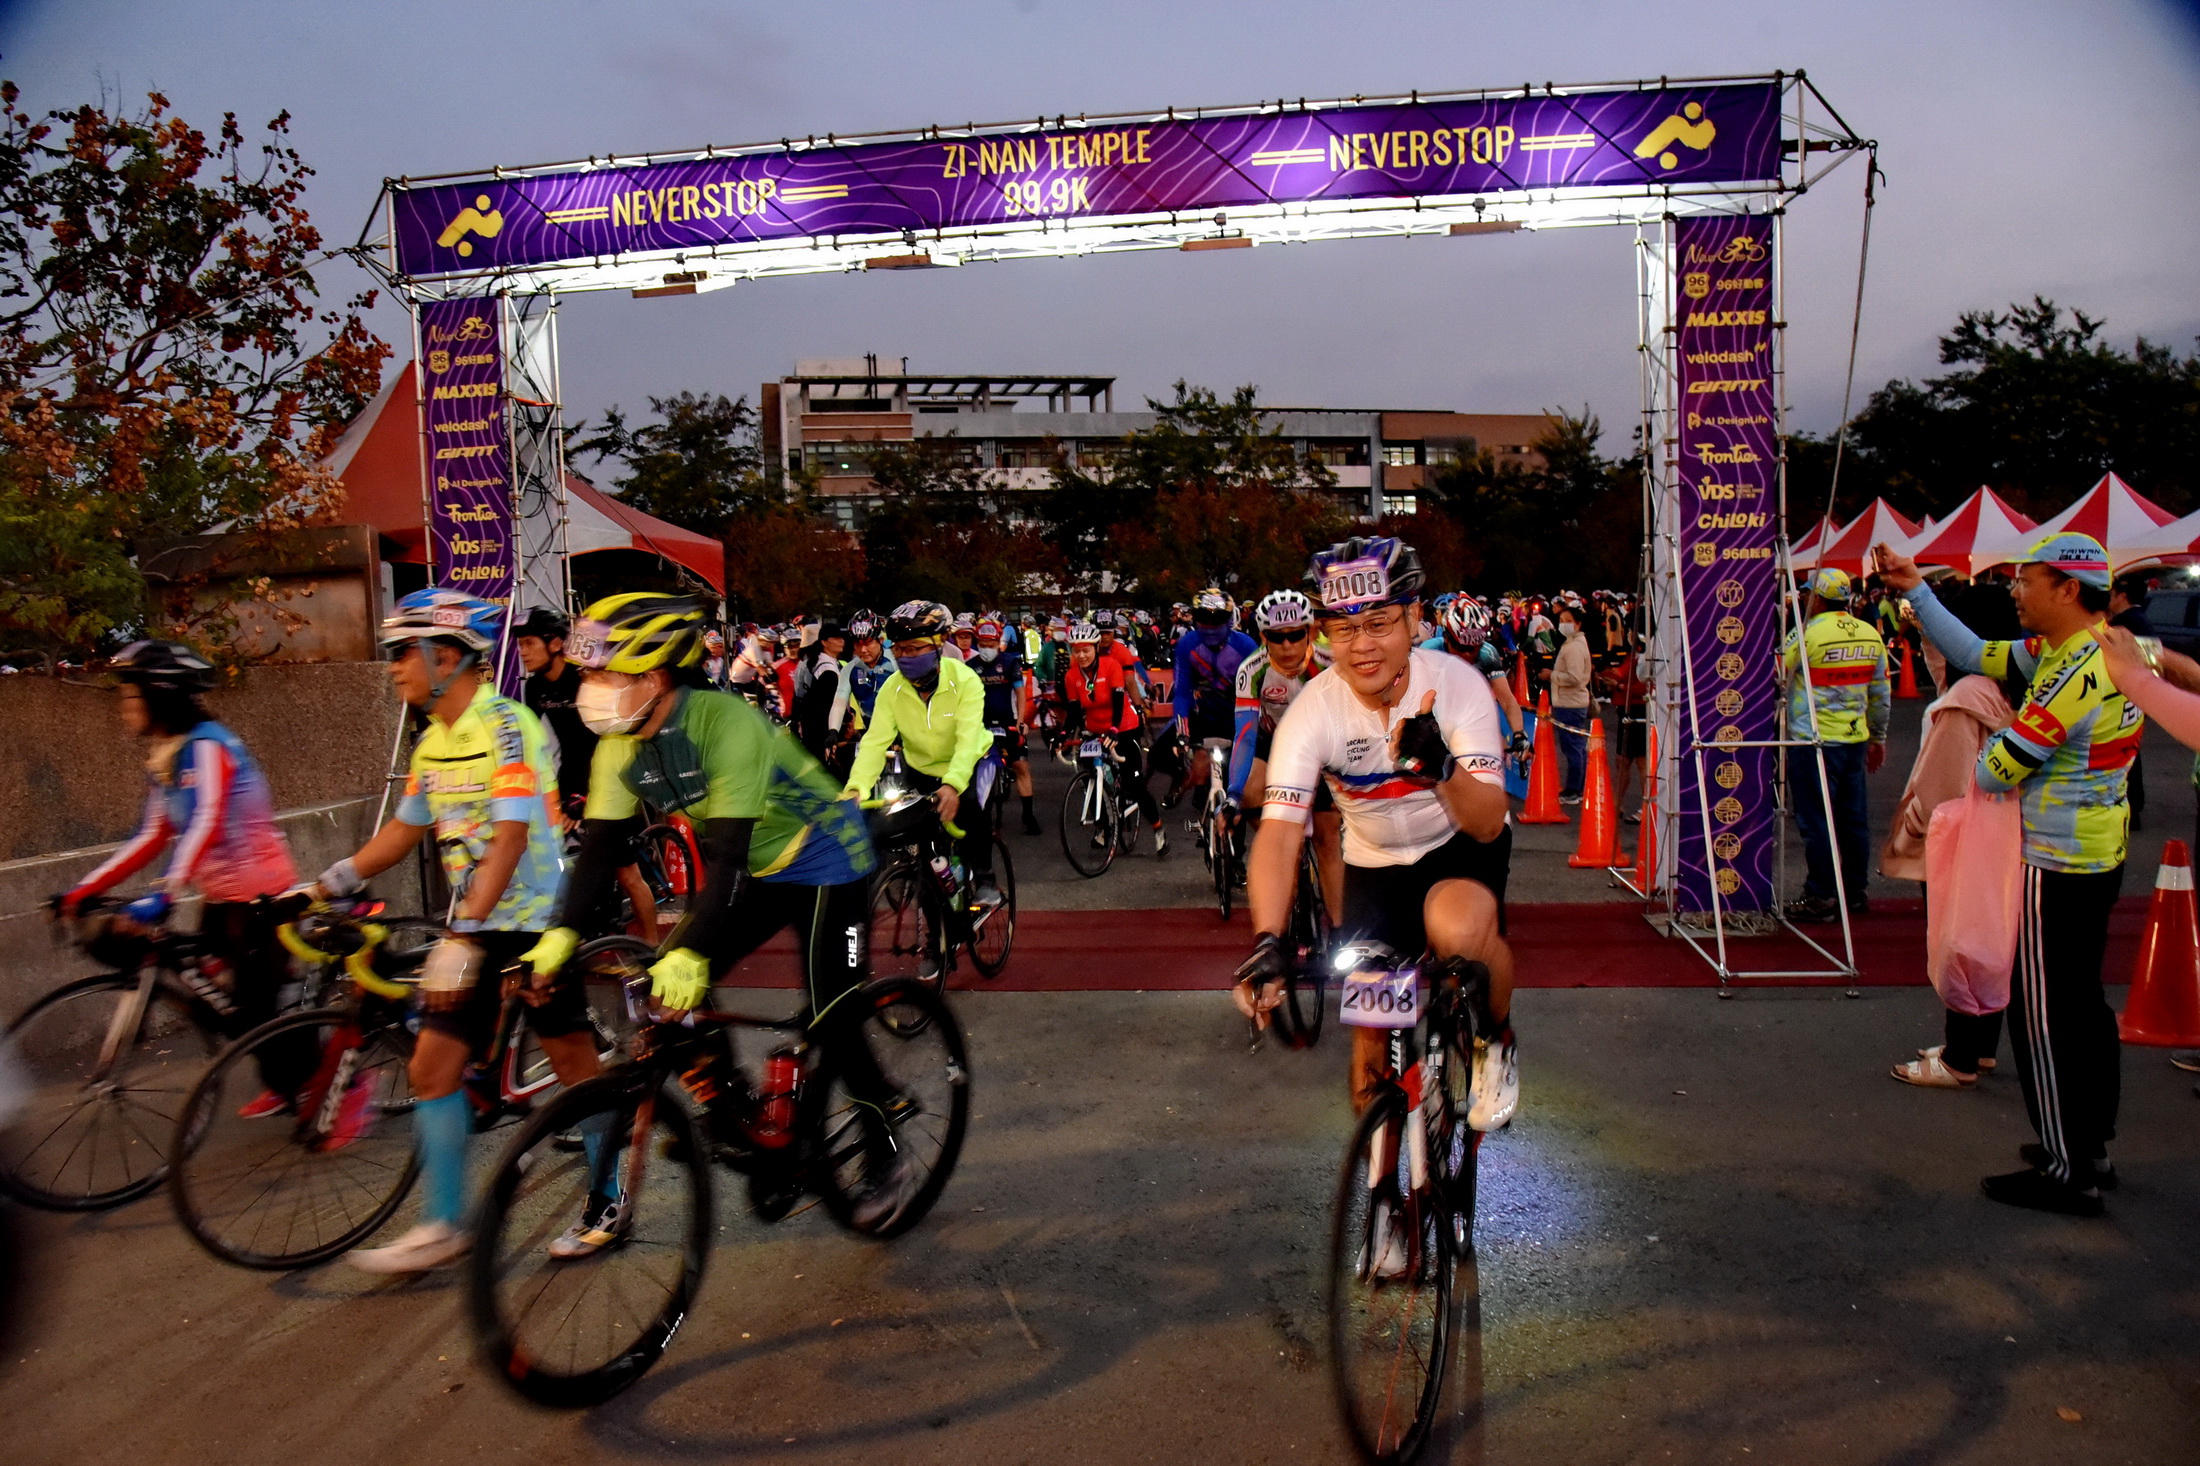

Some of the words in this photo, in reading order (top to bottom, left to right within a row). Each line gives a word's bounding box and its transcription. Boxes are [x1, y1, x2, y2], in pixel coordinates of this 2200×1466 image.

[942, 137, 1037, 179] ZI-NAN
[1045, 129, 1152, 171] TEMPLE
[1329, 125, 1515, 173] NEVERSTOP
[611, 178, 777, 228] NEVERSTOP
[1003, 180, 1091, 217] 99.9K
[1688, 276, 1705, 286] 96
[1686, 310, 1766, 327] MAXXIS
[432, 354, 446, 363] 96
[1686, 350, 1755, 364] velodash
[433, 382, 498, 400] MAXXIS
[1687, 379, 1767, 393] GIANT
[434, 419, 489, 433] velodash
[1705, 416, 1715, 425] AI
[1717, 414, 1768, 426] DesignLife
[436, 444, 500, 460] GIANT
[1694, 442, 1762, 466] Frontier
[452, 479, 460, 488] AI
[461, 477, 503, 488] DesignLife
[1698, 482, 1736, 500] VDS
[444, 503, 501, 524] Frontier
[450, 538, 480, 555] VDS
[1697, 545, 1713, 556] 96
[1323, 571, 1382, 605] 2008
[1274, 608, 1298, 622] 420
[1821, 645, 1879, 663] BULL
[1083, 743, 1099, 753] 444
[1343, 984, 1414, 1014] 2008
[660, 1311, 684, 1349] KENDA
